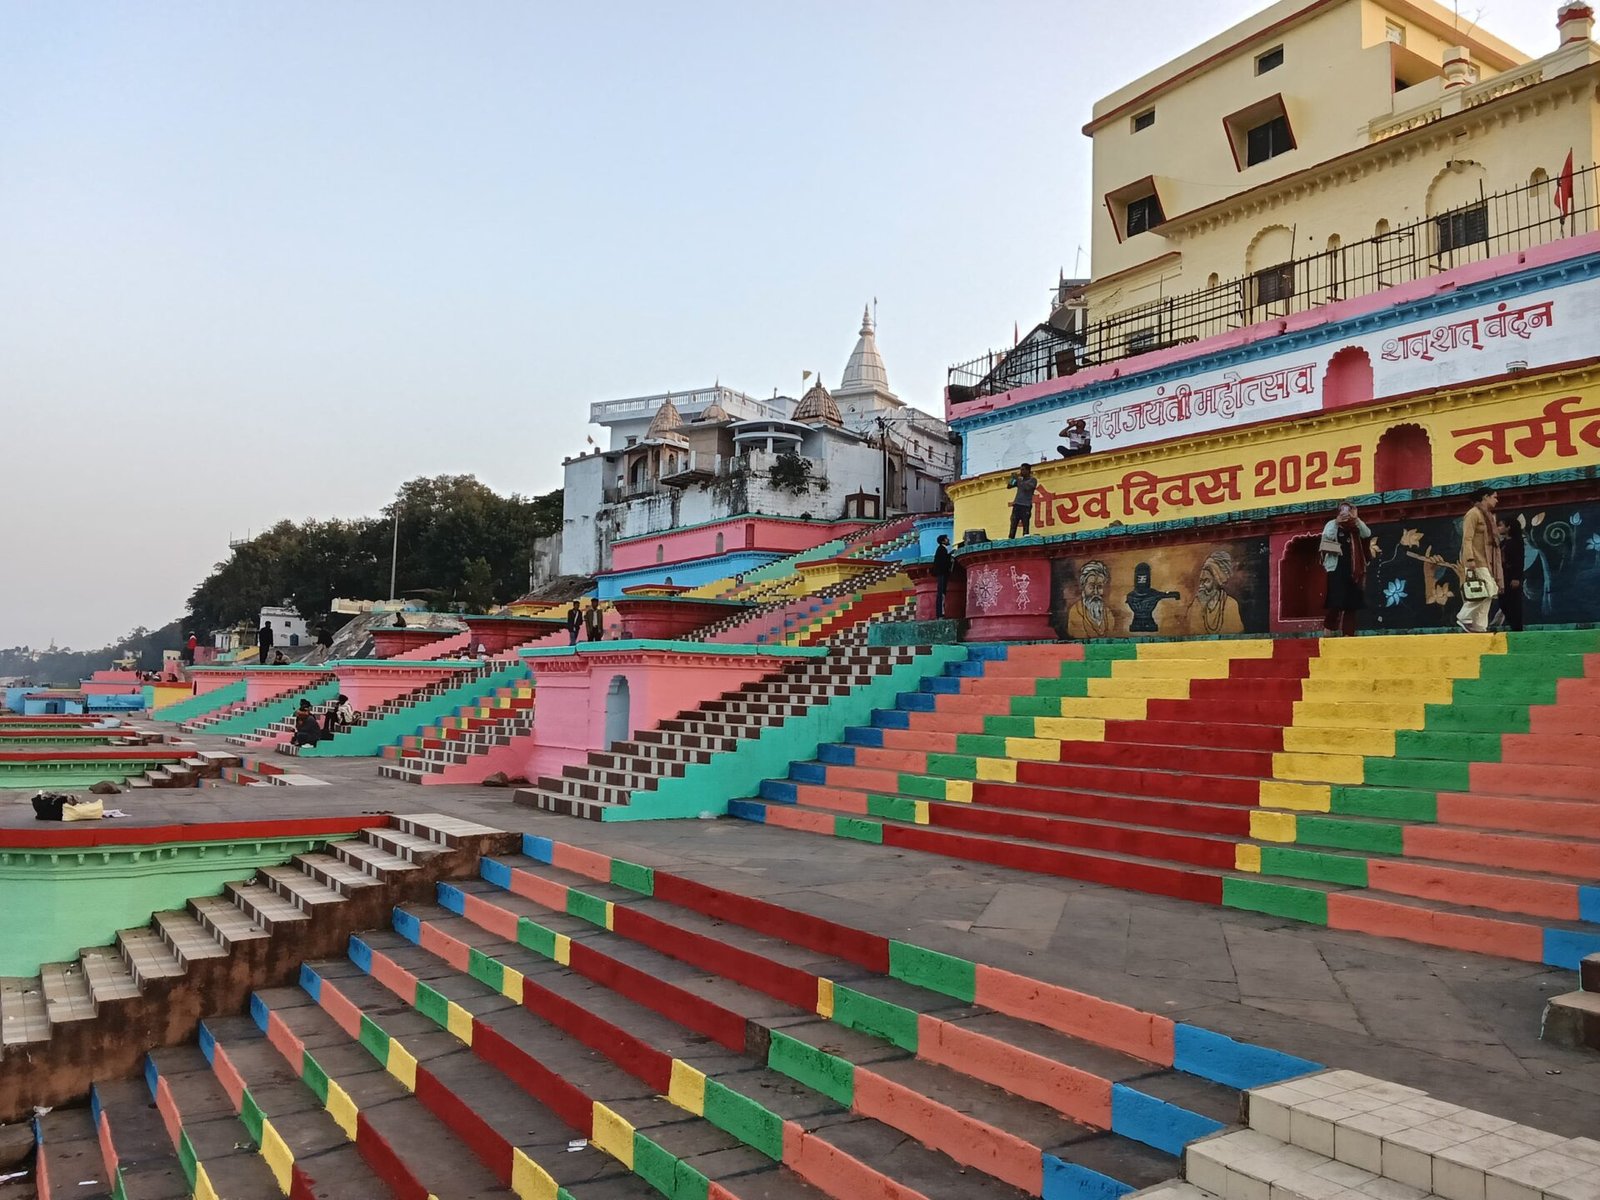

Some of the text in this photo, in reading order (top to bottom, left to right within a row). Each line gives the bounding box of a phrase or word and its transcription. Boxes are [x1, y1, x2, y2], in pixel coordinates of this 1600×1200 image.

[1483, 301, 1554, 339] वंदन
[1072, 362, 1317, 439] र्मदा जयंती महोत्सव
[1116, 464, 1244, 517] दिवस
[1254, 445, 1362, 497] 2025
